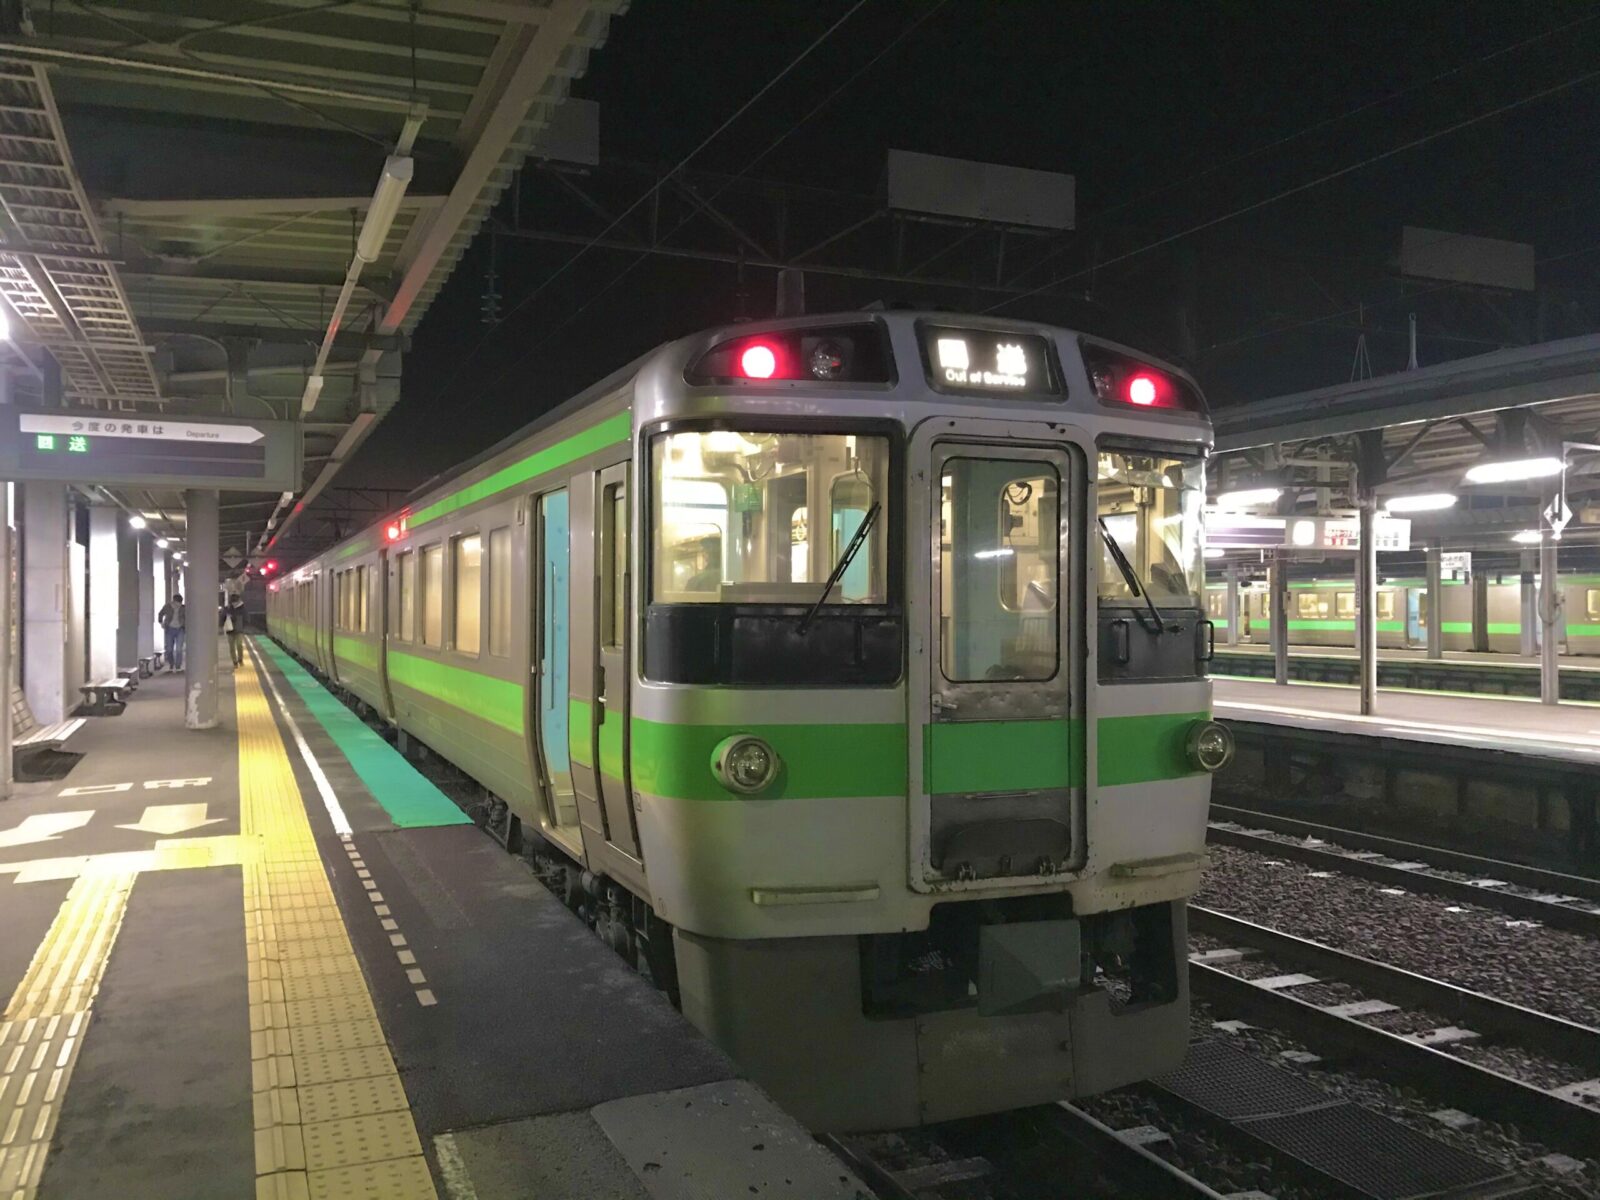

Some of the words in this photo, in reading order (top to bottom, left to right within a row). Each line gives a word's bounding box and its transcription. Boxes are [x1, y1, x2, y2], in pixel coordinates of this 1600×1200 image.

[945, 368, 967, 382] Out
[970, 371, 982, 383] of
[72, 421, 164, 435] 今度の発車は
[186, 429, 220, 439] Departure
